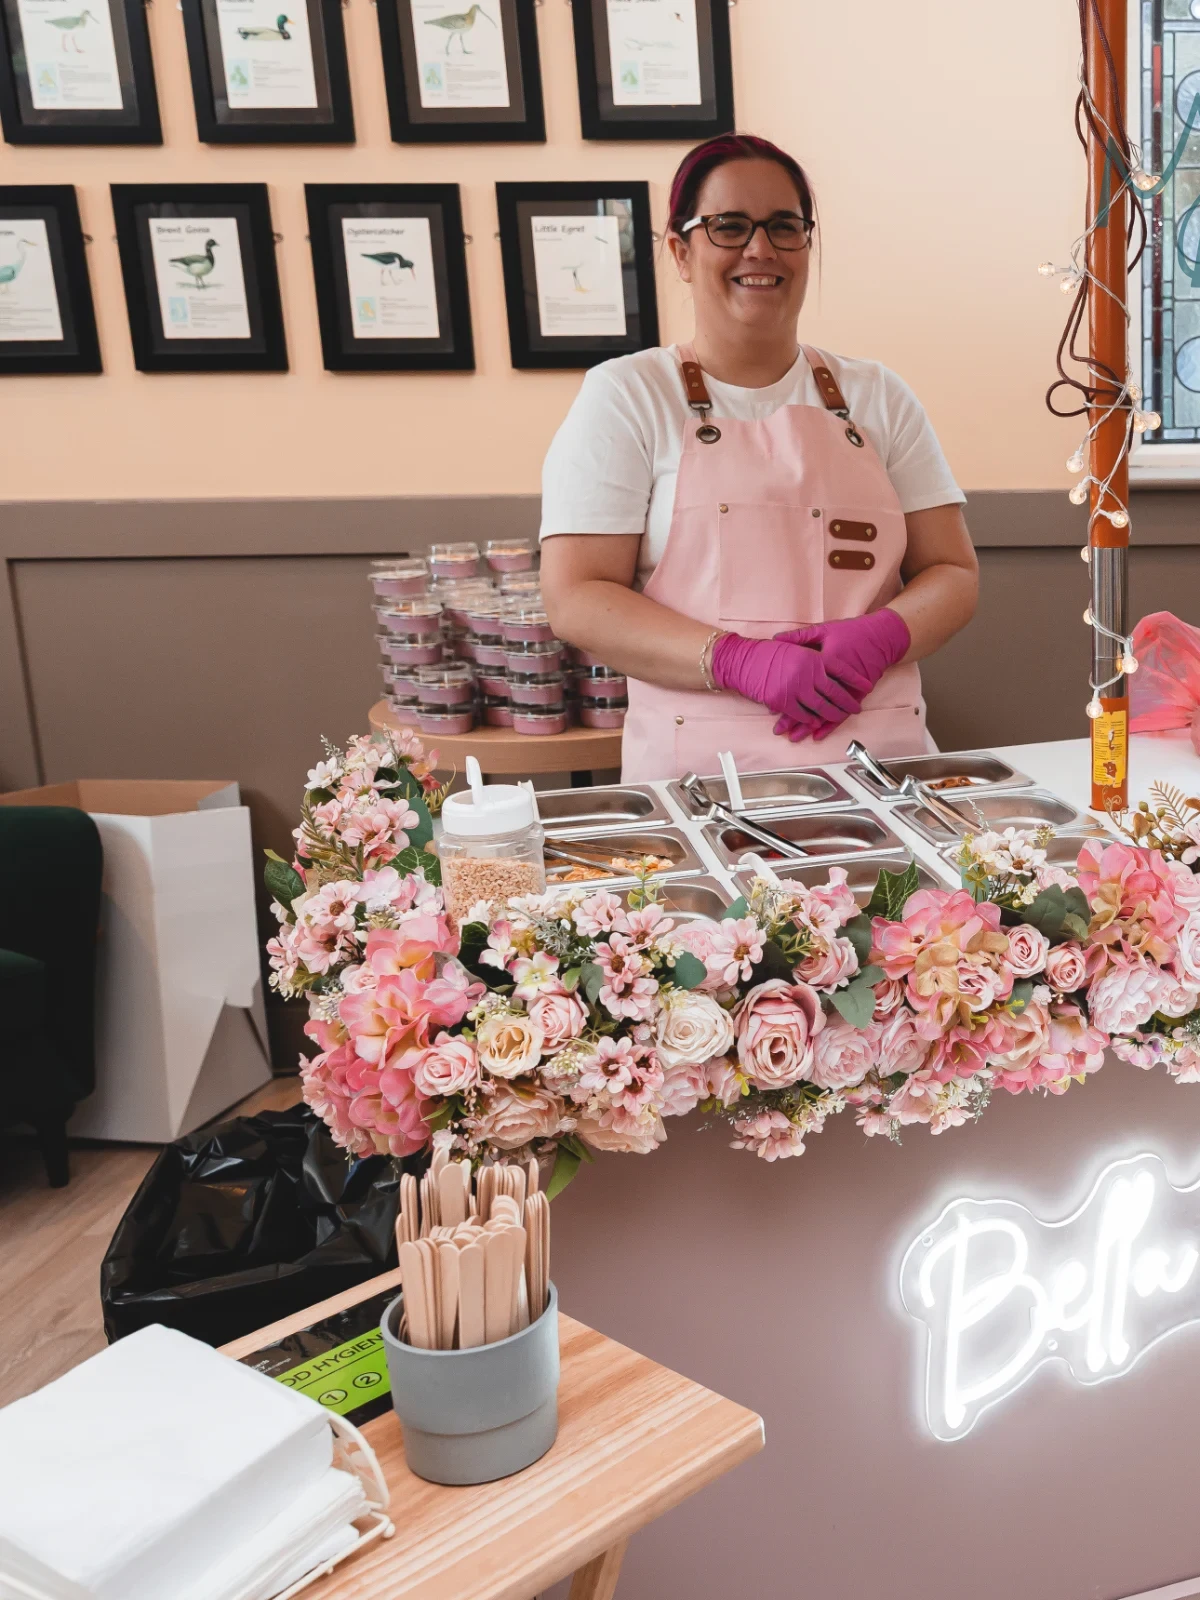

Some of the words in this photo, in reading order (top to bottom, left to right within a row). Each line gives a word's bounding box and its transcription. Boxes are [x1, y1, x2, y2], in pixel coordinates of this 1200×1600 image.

[535, 225, 557, 233] Little
[561, 226, 585, 235] Egret
[918, 1169, 1200, 1429] Bella
[312, 1331, 384, 1372] HYGIEN
